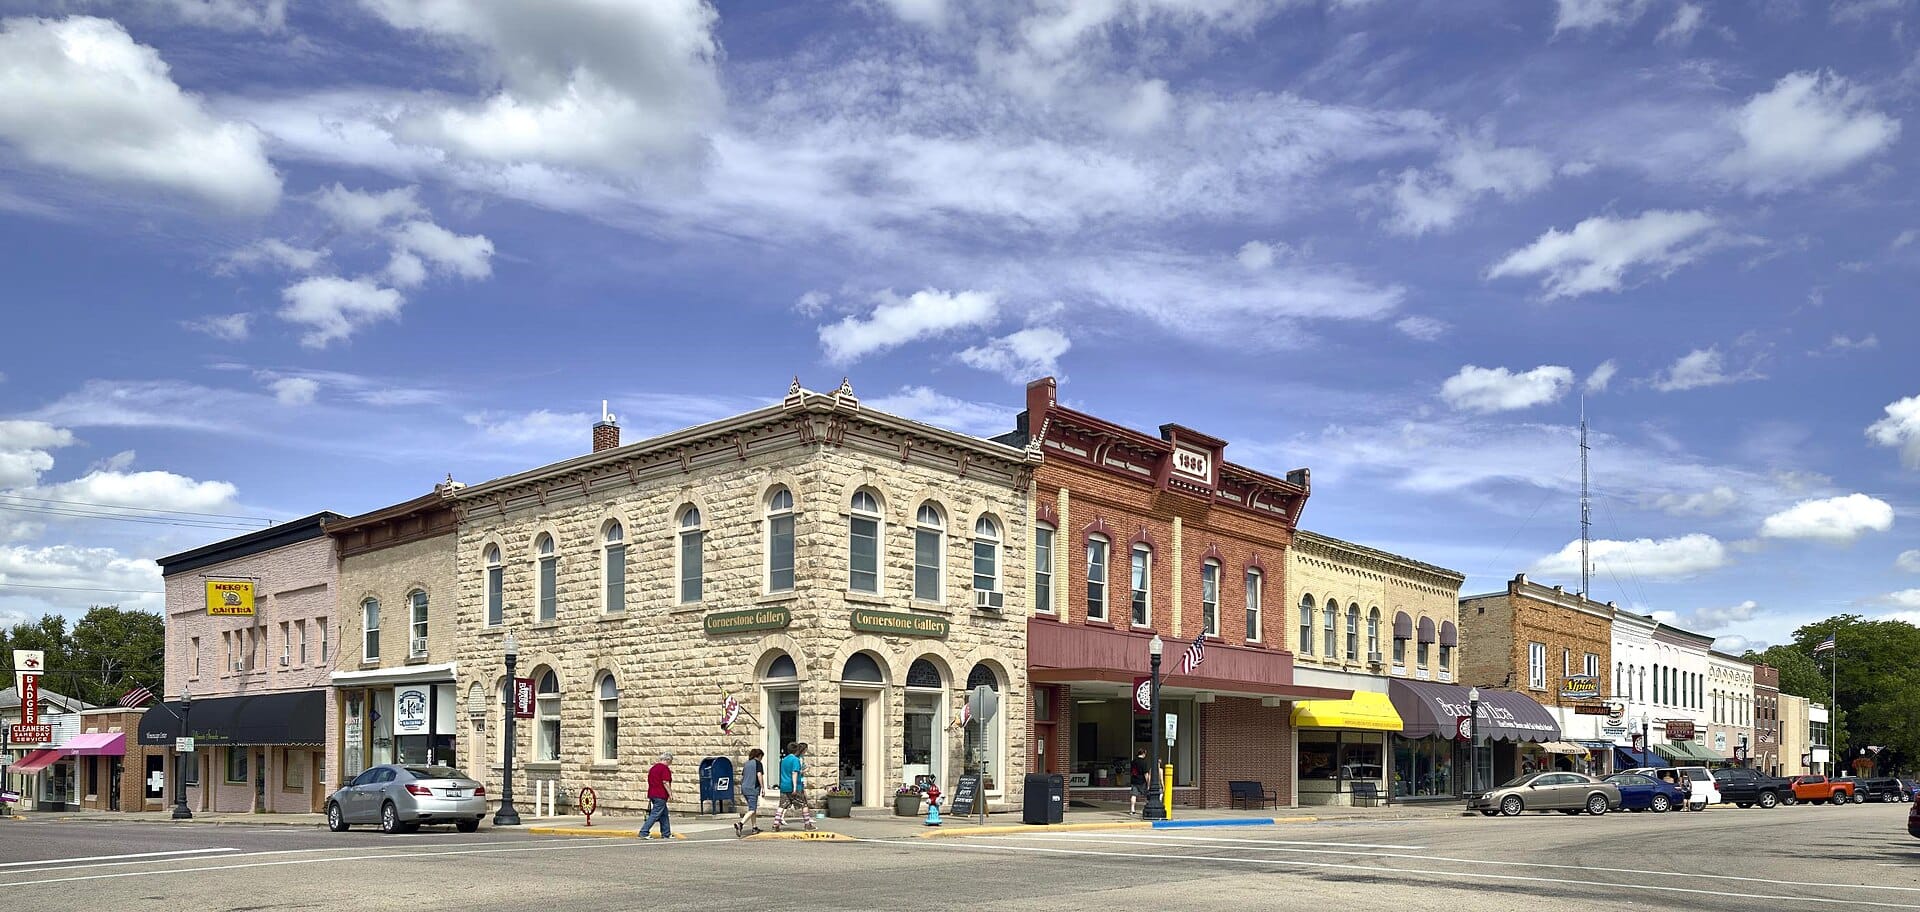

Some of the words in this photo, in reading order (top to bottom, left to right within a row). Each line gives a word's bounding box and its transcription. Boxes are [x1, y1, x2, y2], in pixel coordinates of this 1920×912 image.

[1179, 453, 1203, 471] 1886
[707, 615, 754, 628] Cornerstone
[756, 611, 785, 624] Gallery
[856, 612, 912, 629] Cornerstone
[914, 618, 945, 634] Gallery
[1563, 679, 1598, 692] Alpine
[26, 675, 34, 724] BADGER
